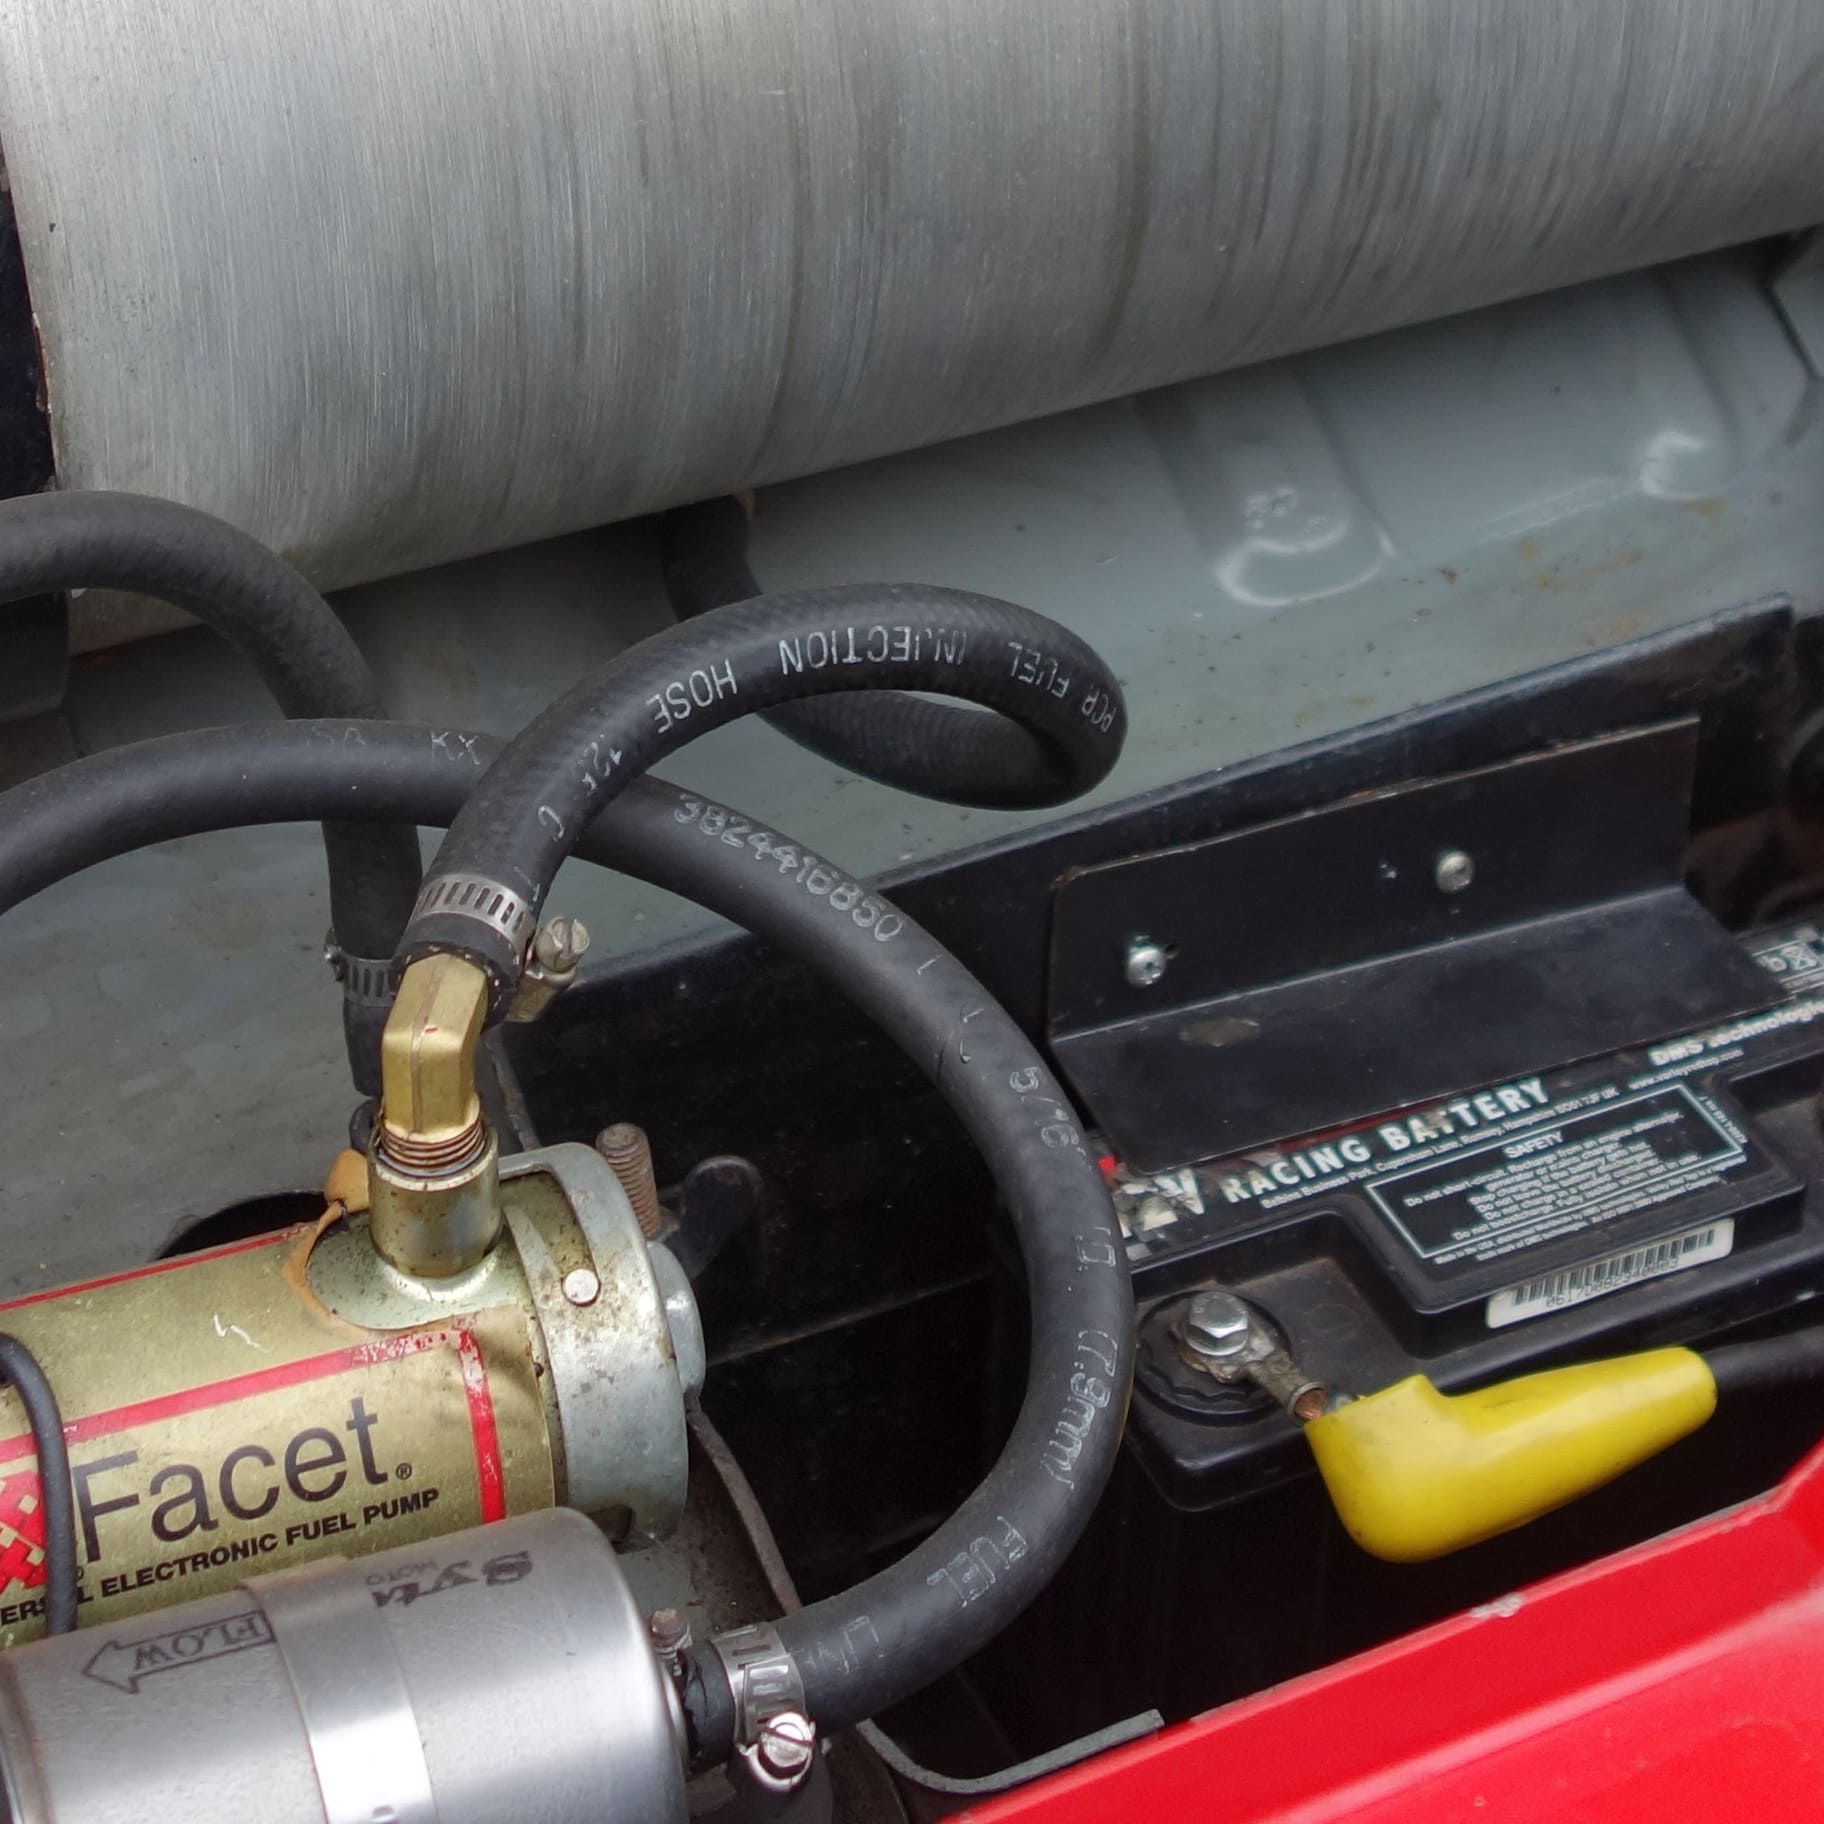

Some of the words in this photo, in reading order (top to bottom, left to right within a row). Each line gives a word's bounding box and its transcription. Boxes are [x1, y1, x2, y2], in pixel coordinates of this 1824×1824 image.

[778, 624, 968, 676] INJECTION
[1007, 641, 1071, 699] FUEL
[650, 658, 739, 734] HOSE
[1219, 1136, 1371, 1203] RACING
[1379, 1078, 1550, 1151] BATTERY
[1503, 1132, 1563, 1158] SAFETY
[672, 792, 905, 944] 3824416850
[926, 1514, 1031, 1610] FUEL
[71, 1396, 389, 1565] Facet
[101, 1533, 278, 1596] ELECTRONIC
[286, 1512, 356, 1546] FUEL
[363, 1487, 441, 1526] PUMP
[134, 1614, 263, 1672] FLOW
